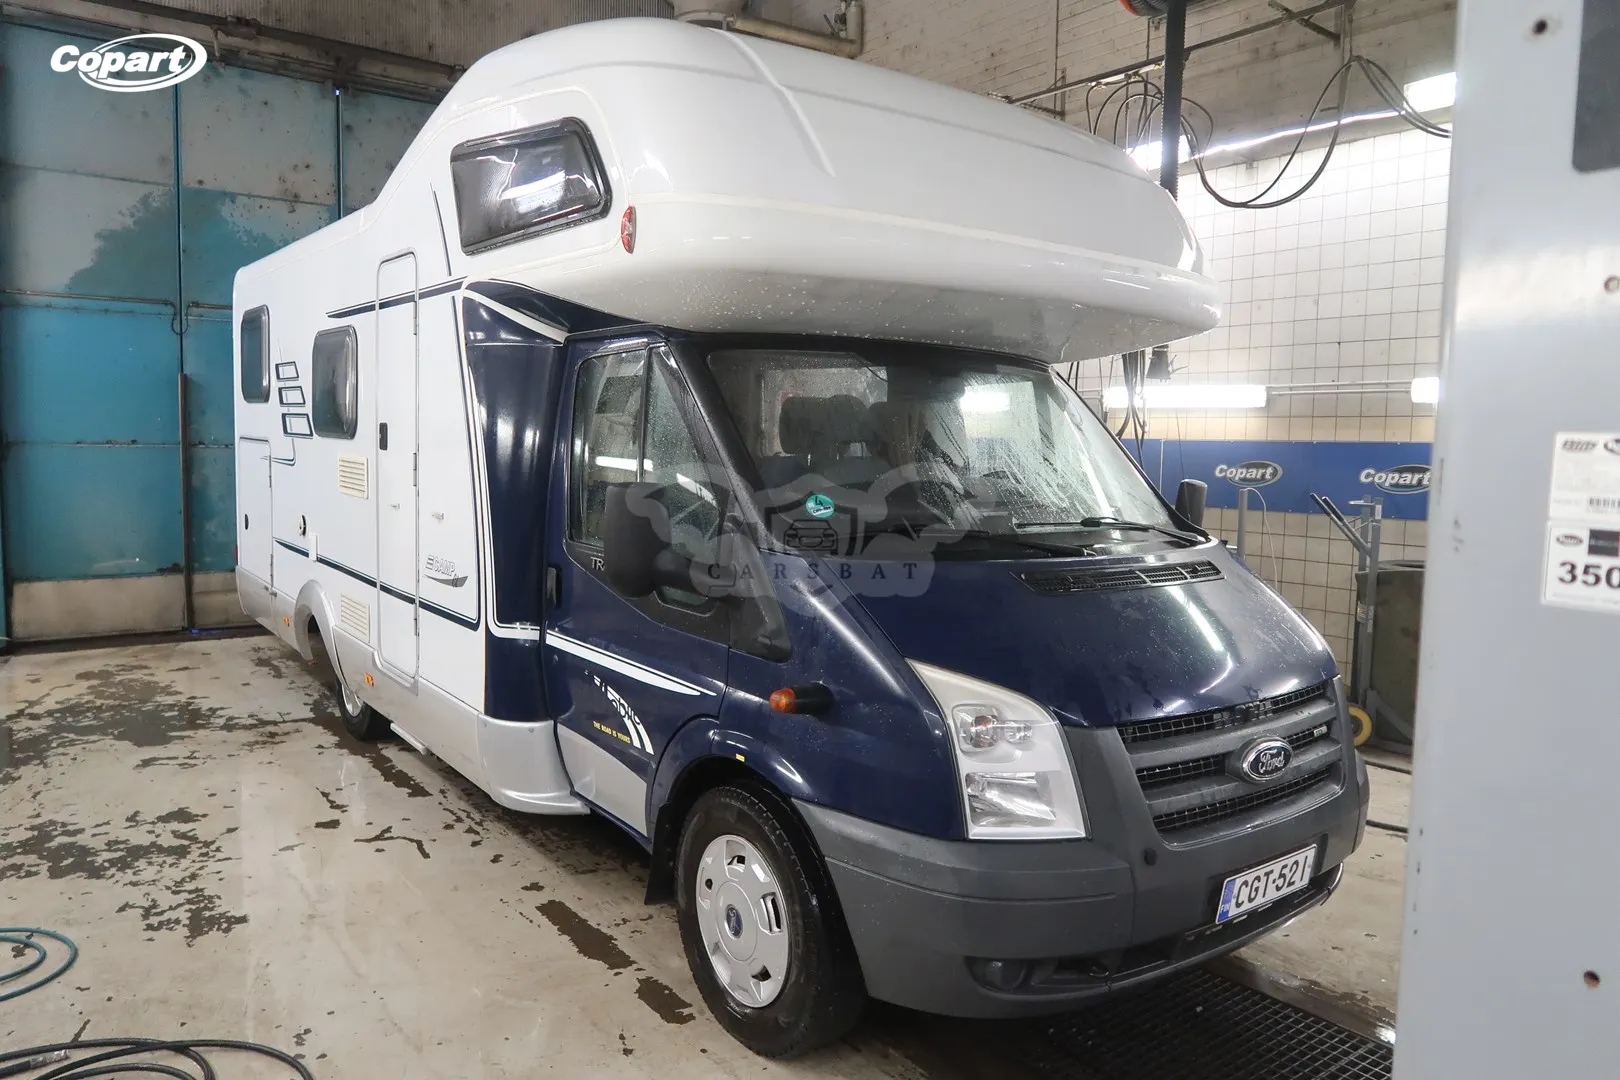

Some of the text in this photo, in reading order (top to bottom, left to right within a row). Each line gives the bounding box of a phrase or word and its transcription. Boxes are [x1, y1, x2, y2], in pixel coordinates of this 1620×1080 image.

[1214, 463, 1274, 482] Copart
[1358, 467, 1432, 487] Copart
[593, 720, 601, 730] THE
[601, 724, 612, 735] ROAD
[616, 732, 631, 744] YOURS
[1259, 748, 1285, 774] Ford
[1235, 855, 1308, 909] CGT-521
